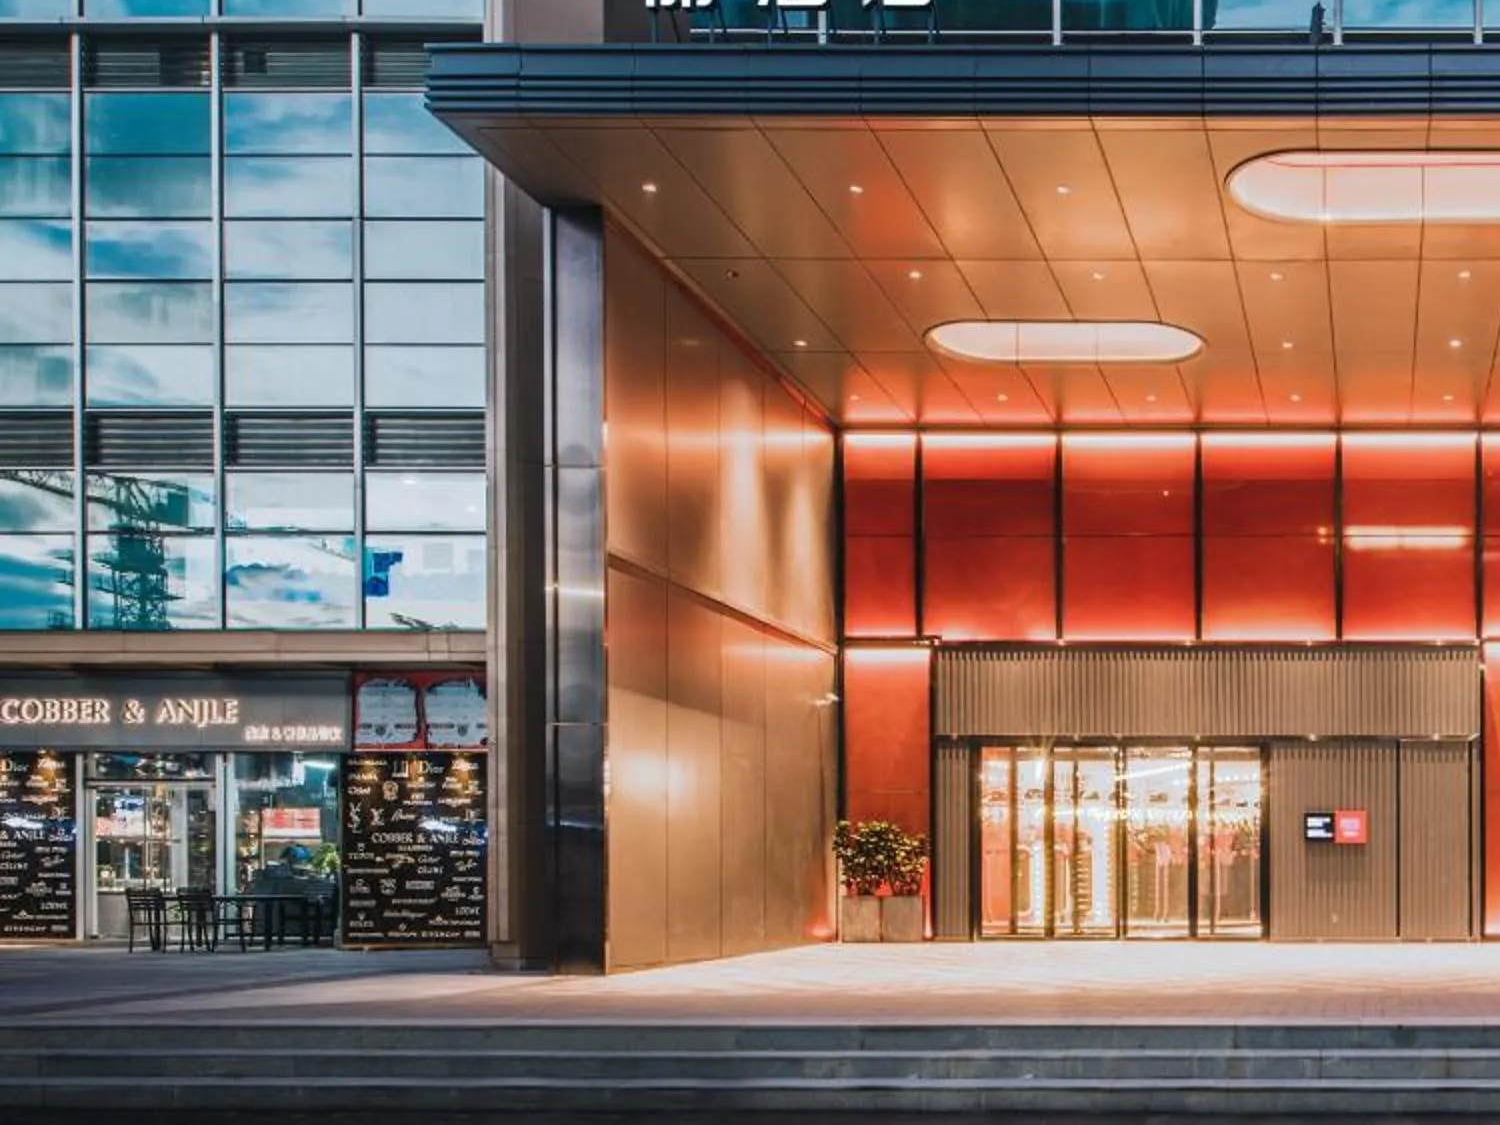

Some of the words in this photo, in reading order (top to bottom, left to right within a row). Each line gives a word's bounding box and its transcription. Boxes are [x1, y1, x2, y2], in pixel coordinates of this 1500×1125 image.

[0, 698, 110, 725] COBBER
[121, 699, 146, 725] &
[156, 698, 240, 728] ANJLE
